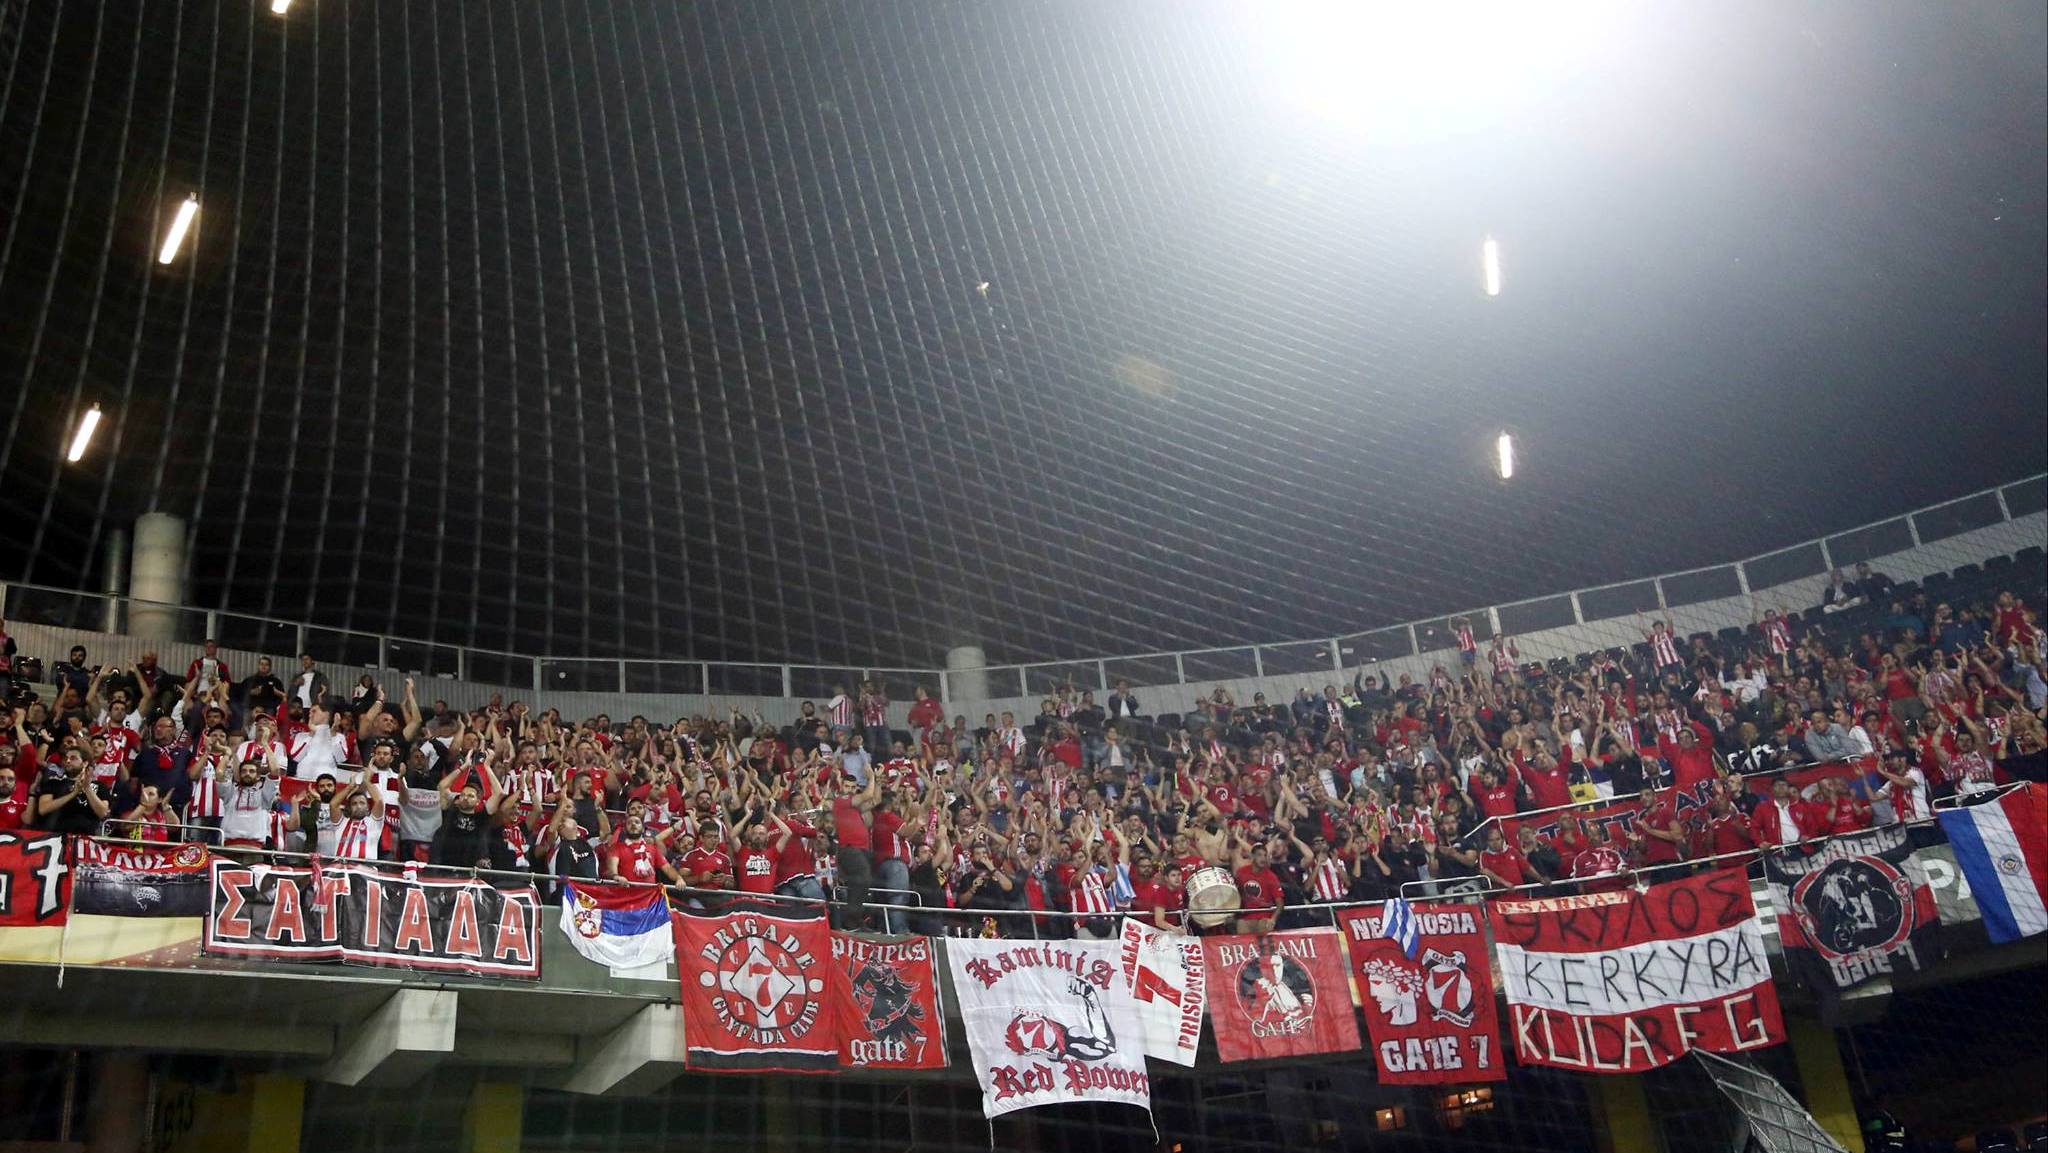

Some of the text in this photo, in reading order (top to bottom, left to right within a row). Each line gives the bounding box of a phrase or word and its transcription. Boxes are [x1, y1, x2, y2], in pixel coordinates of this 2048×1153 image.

[27, 834, 69, 916] 7
[77, 838, 174, 869] ΠΥΛΟΣ
[701, 918, 817, 971] BRIGADE
[1217, 937, 1318, 967] BRAAMI
[748, 961, 774, 1007] 7
[1133, 964, 1182, 1008] 7
[1432, 968, 1461, 1012] 7
[1523, 930, 1761, 1006] KERKYRA
[1177, 943, 1205, 1051] PRISONERS
[711, 996, 821, 1045] GLYFADA CLUB
[850, 1033, 928, 1066] gate 7
[1380, 1034, 1489, 1073] GATE 7
[989, 1058, 1150, 1102] Red Power
